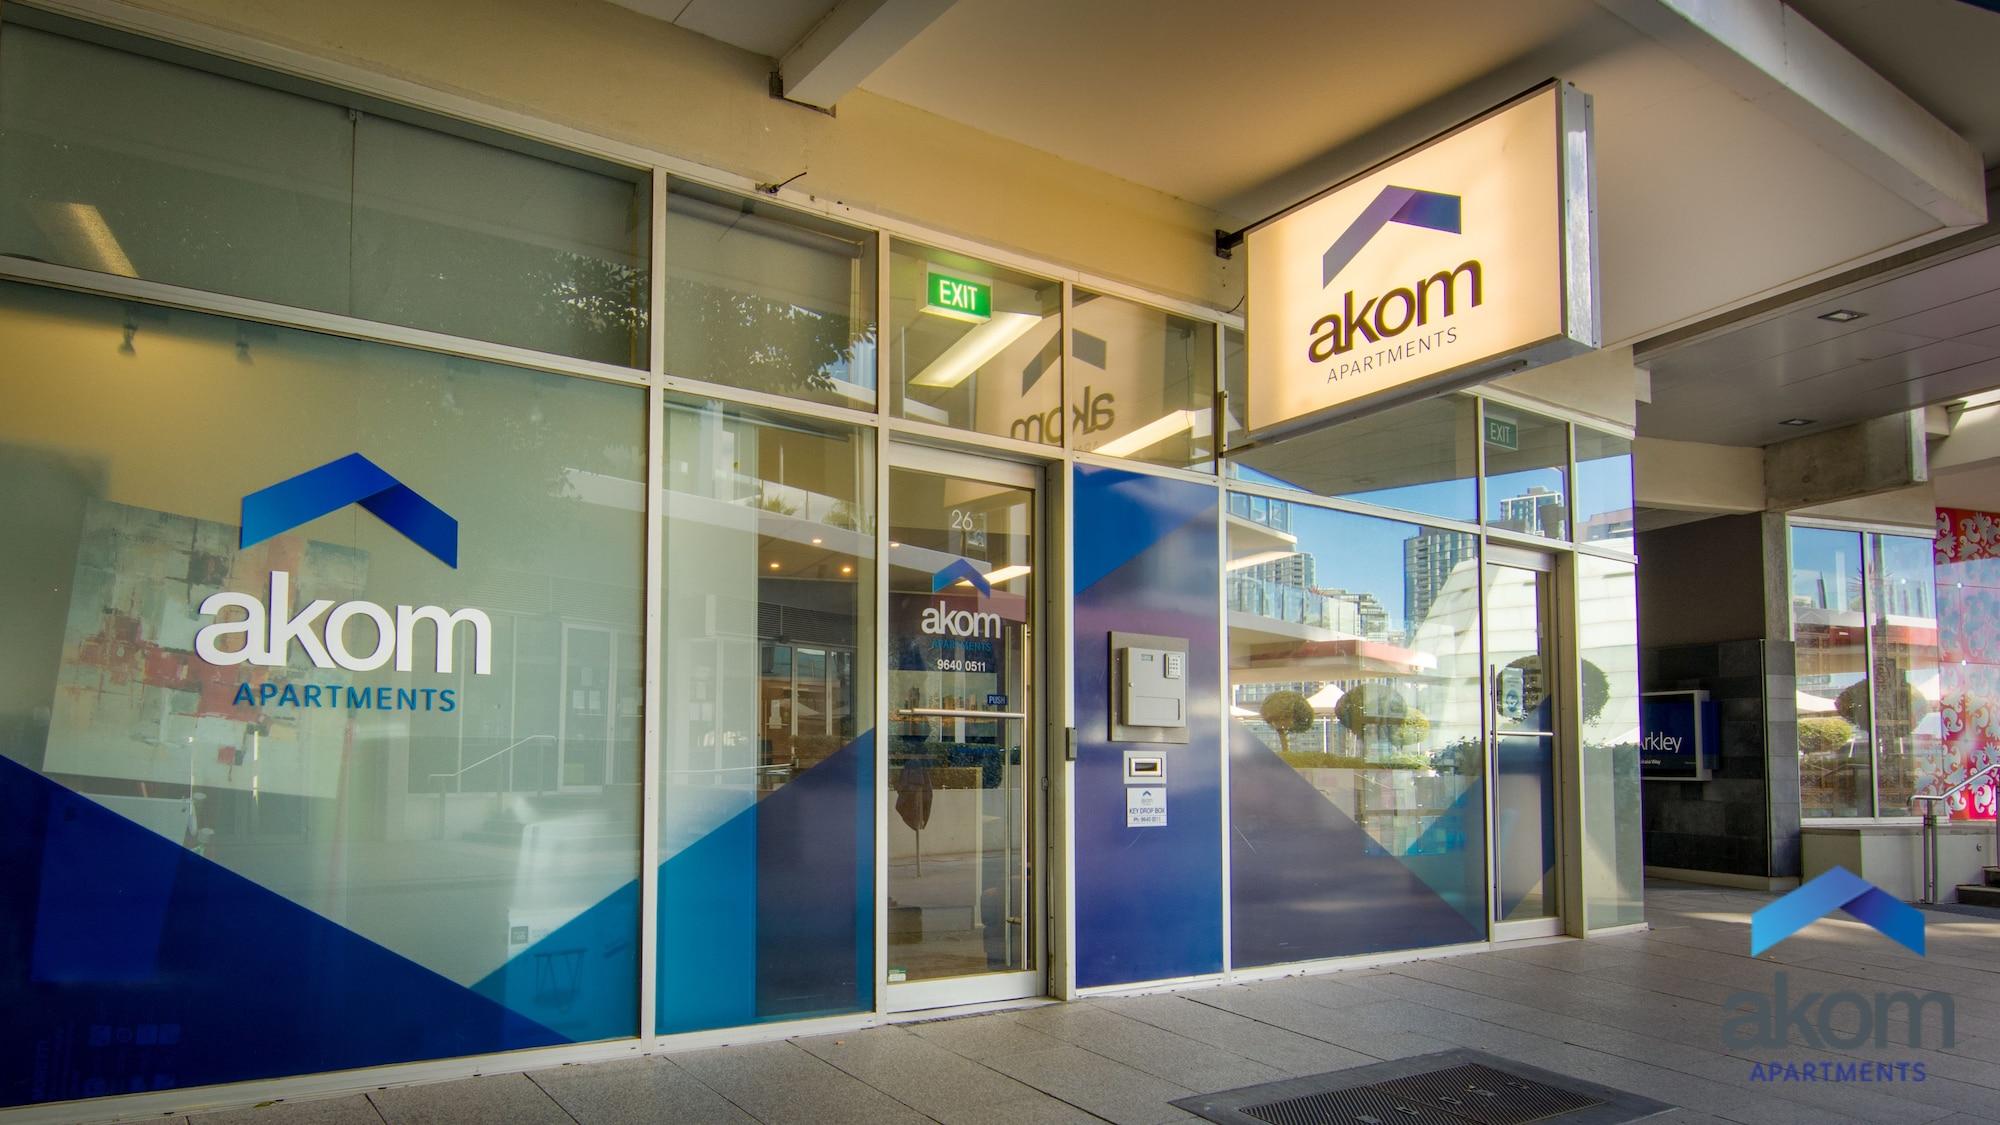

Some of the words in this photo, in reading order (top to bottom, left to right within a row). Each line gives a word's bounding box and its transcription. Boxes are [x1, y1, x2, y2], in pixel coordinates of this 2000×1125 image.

[939, 279, 978, 311] EXIT
[1308, 259, 1483, 364] akom
[1326, 326, 1458, 384] APARTMENTS
[1490, 422, 1510, 444] EXIT
[951, 509, 973, 530] 26
[195, 570, 492, 675] akom
[921, 600, 1001, 639] akom
[937, 659, 962, 671] 9640
[964, 661, 986, 673] 0511
[232, 682, 456, 712] APARTMENTS
[988, 695, 1006, 705] PUSH
